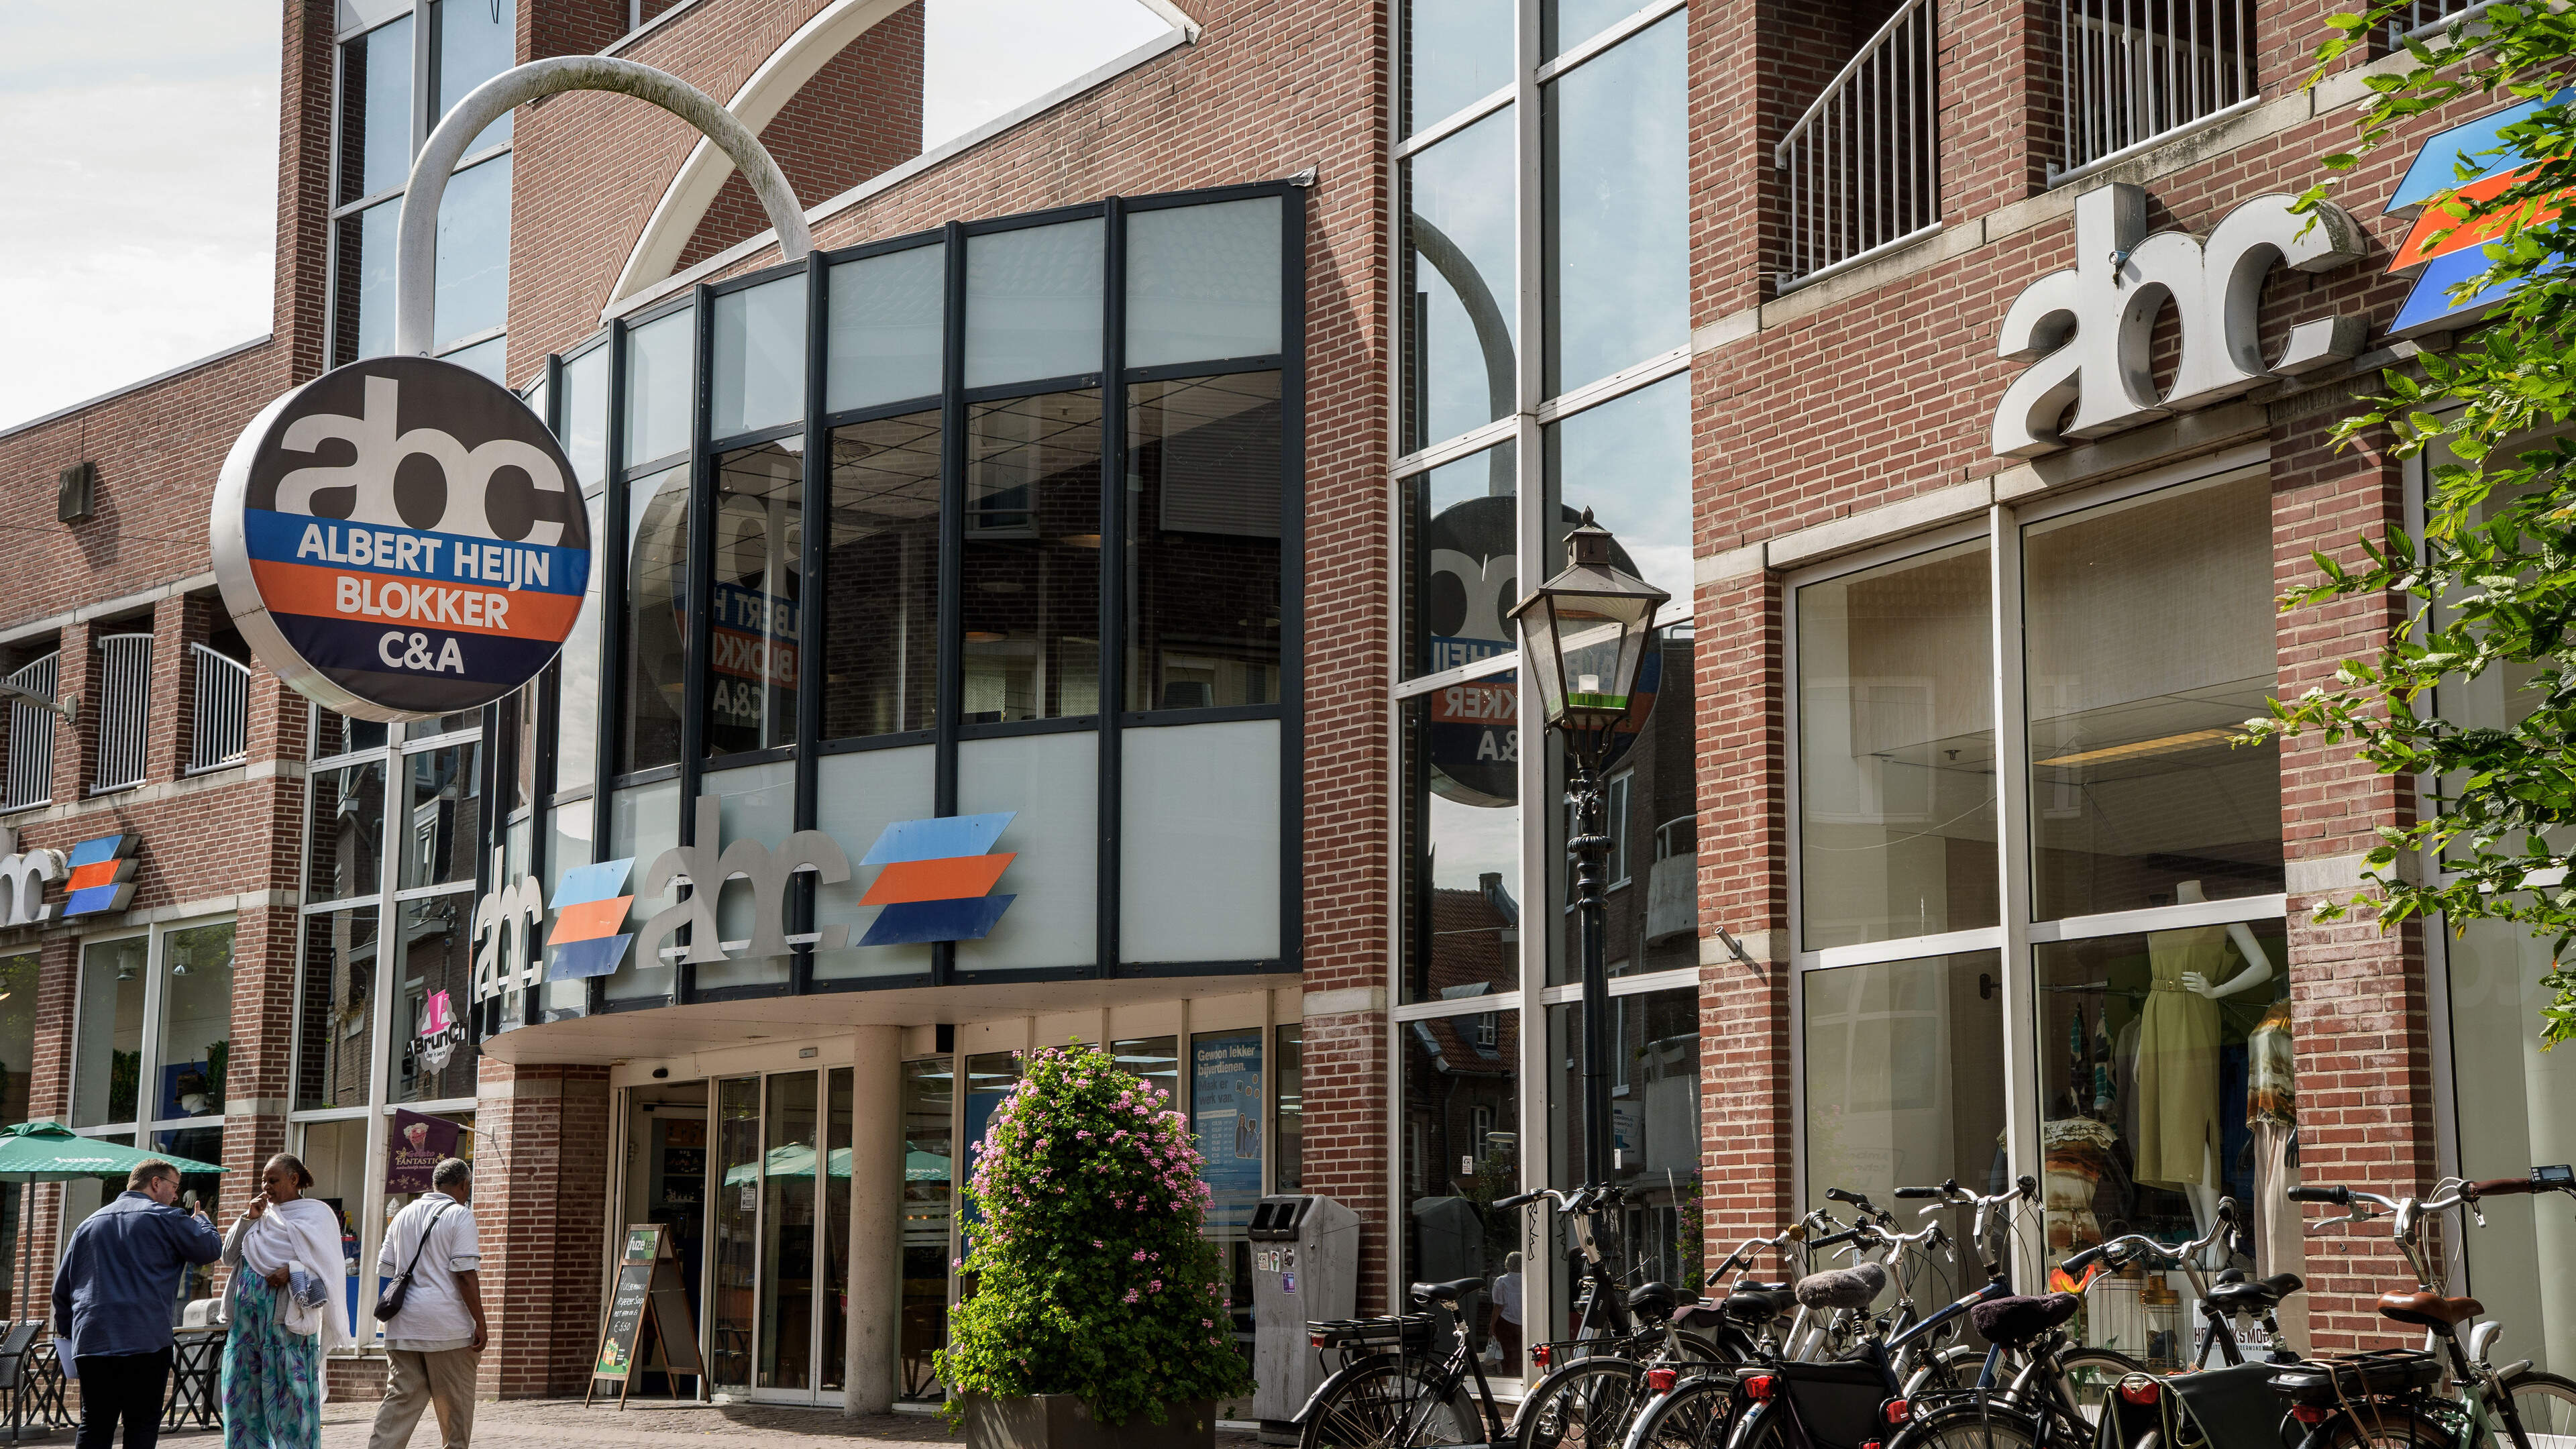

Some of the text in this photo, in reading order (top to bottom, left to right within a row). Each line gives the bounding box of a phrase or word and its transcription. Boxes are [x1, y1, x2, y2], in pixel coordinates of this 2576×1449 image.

[1991, 182, 2369, 460] abc
[275, 374, 565, 547] abc
[297, 523, 550, 592] ALBERT HEIJN
[336, 576, 510, 630] BLOKKER
[378, 631, 465, 674] C&A
[635, 794, 851, 969] abc
[474, 844, 543, 1004] abc
[1197, 1044, 1256, 1061] Gewoon lekker
[1197, 1061, 1246, 1078] bijverdienen.
[1198, 1078, 1229, 1091] Maak er
[1198, 1092, 1234, 1106] werk van.
[396, 1157, 446, 1165] FANTASTIC
